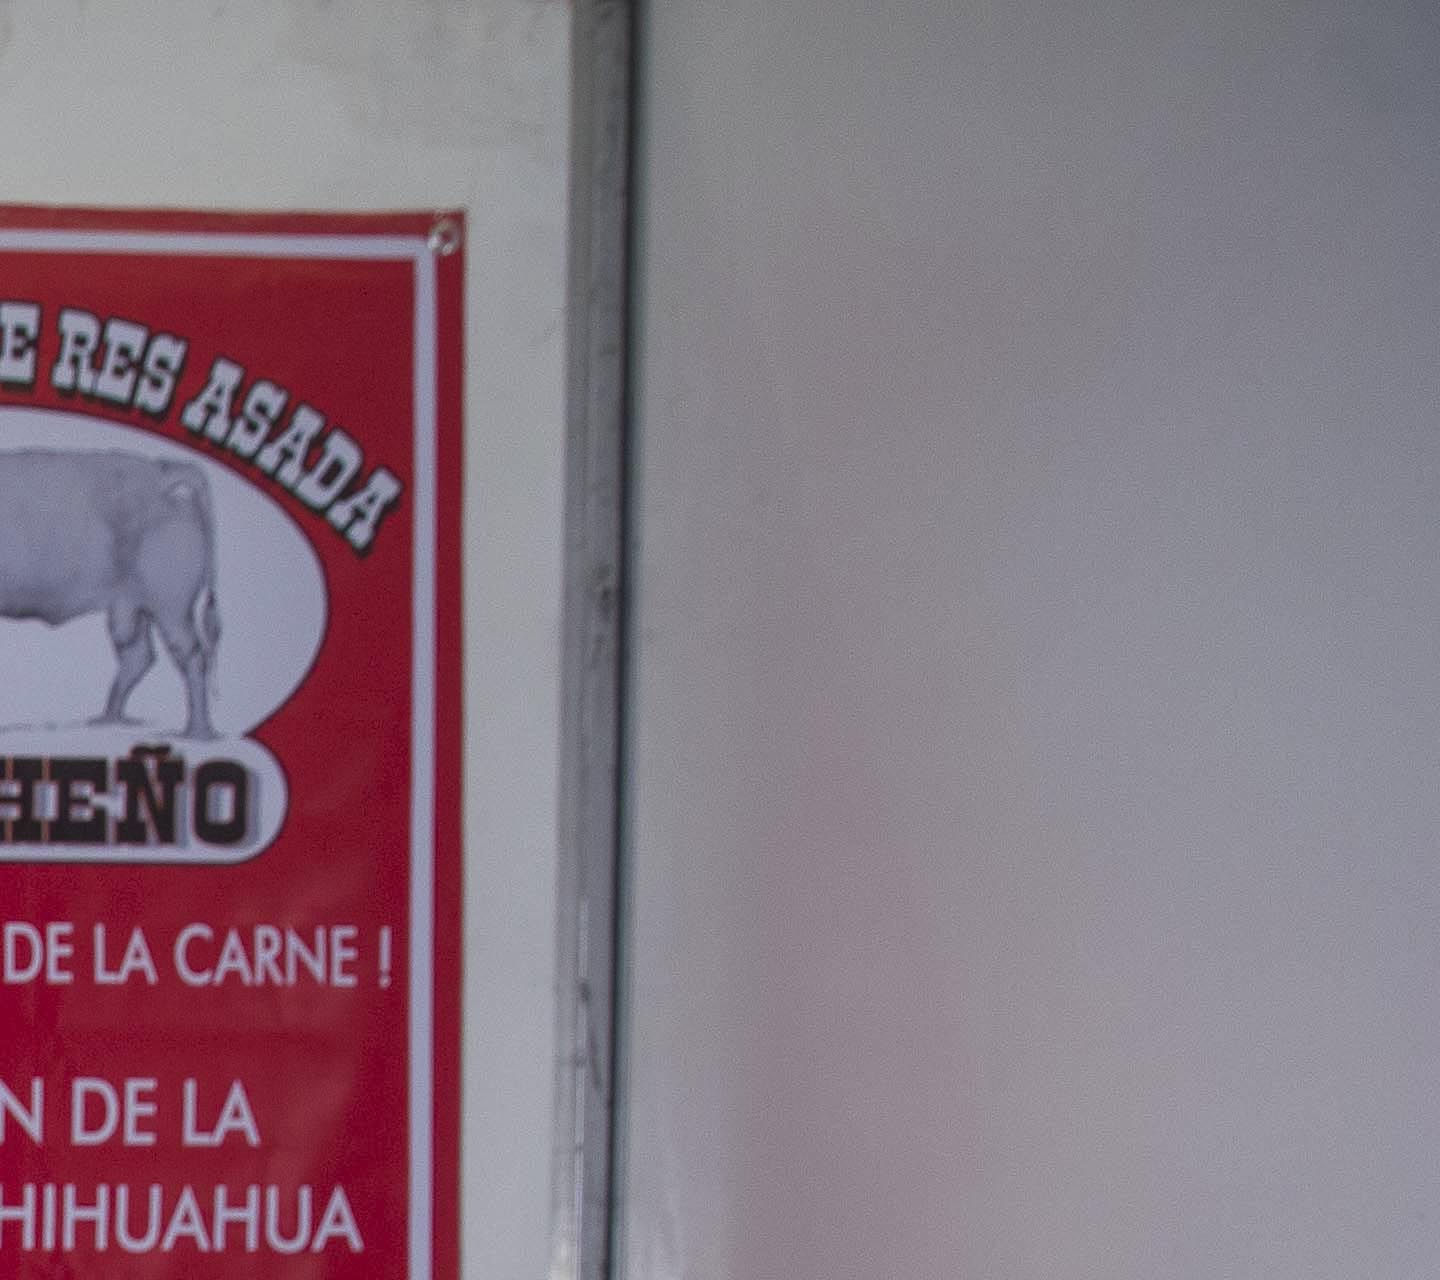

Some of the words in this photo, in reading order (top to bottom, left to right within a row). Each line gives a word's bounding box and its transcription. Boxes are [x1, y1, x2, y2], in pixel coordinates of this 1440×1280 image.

[51, 304, 188, 411] RES
[184, 354, 404, 549] ASADA
[3, 922, 73, 984] DE
[93, 923, 158, 985] LA
[174, 923, 357, 988] CARNE
[71, 1078, 157, 1146] DE
[183, 1079, 260, 1146] LA
